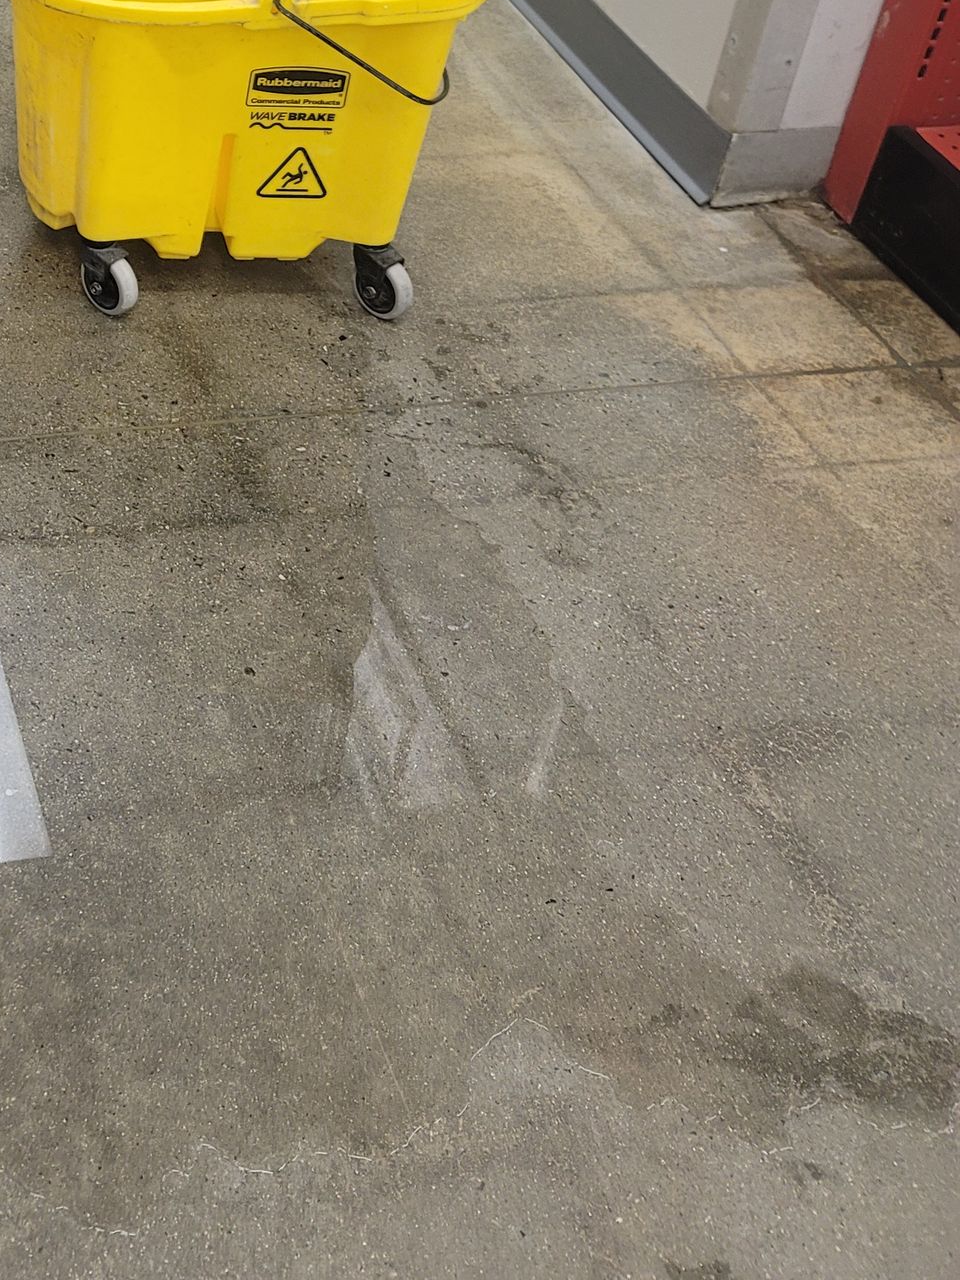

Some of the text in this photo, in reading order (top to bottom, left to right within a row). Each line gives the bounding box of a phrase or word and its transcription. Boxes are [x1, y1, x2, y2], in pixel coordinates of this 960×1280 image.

[256, 77, 342, 89] Rubbermaid
[251, 97, 341, 106] Commercial Products
